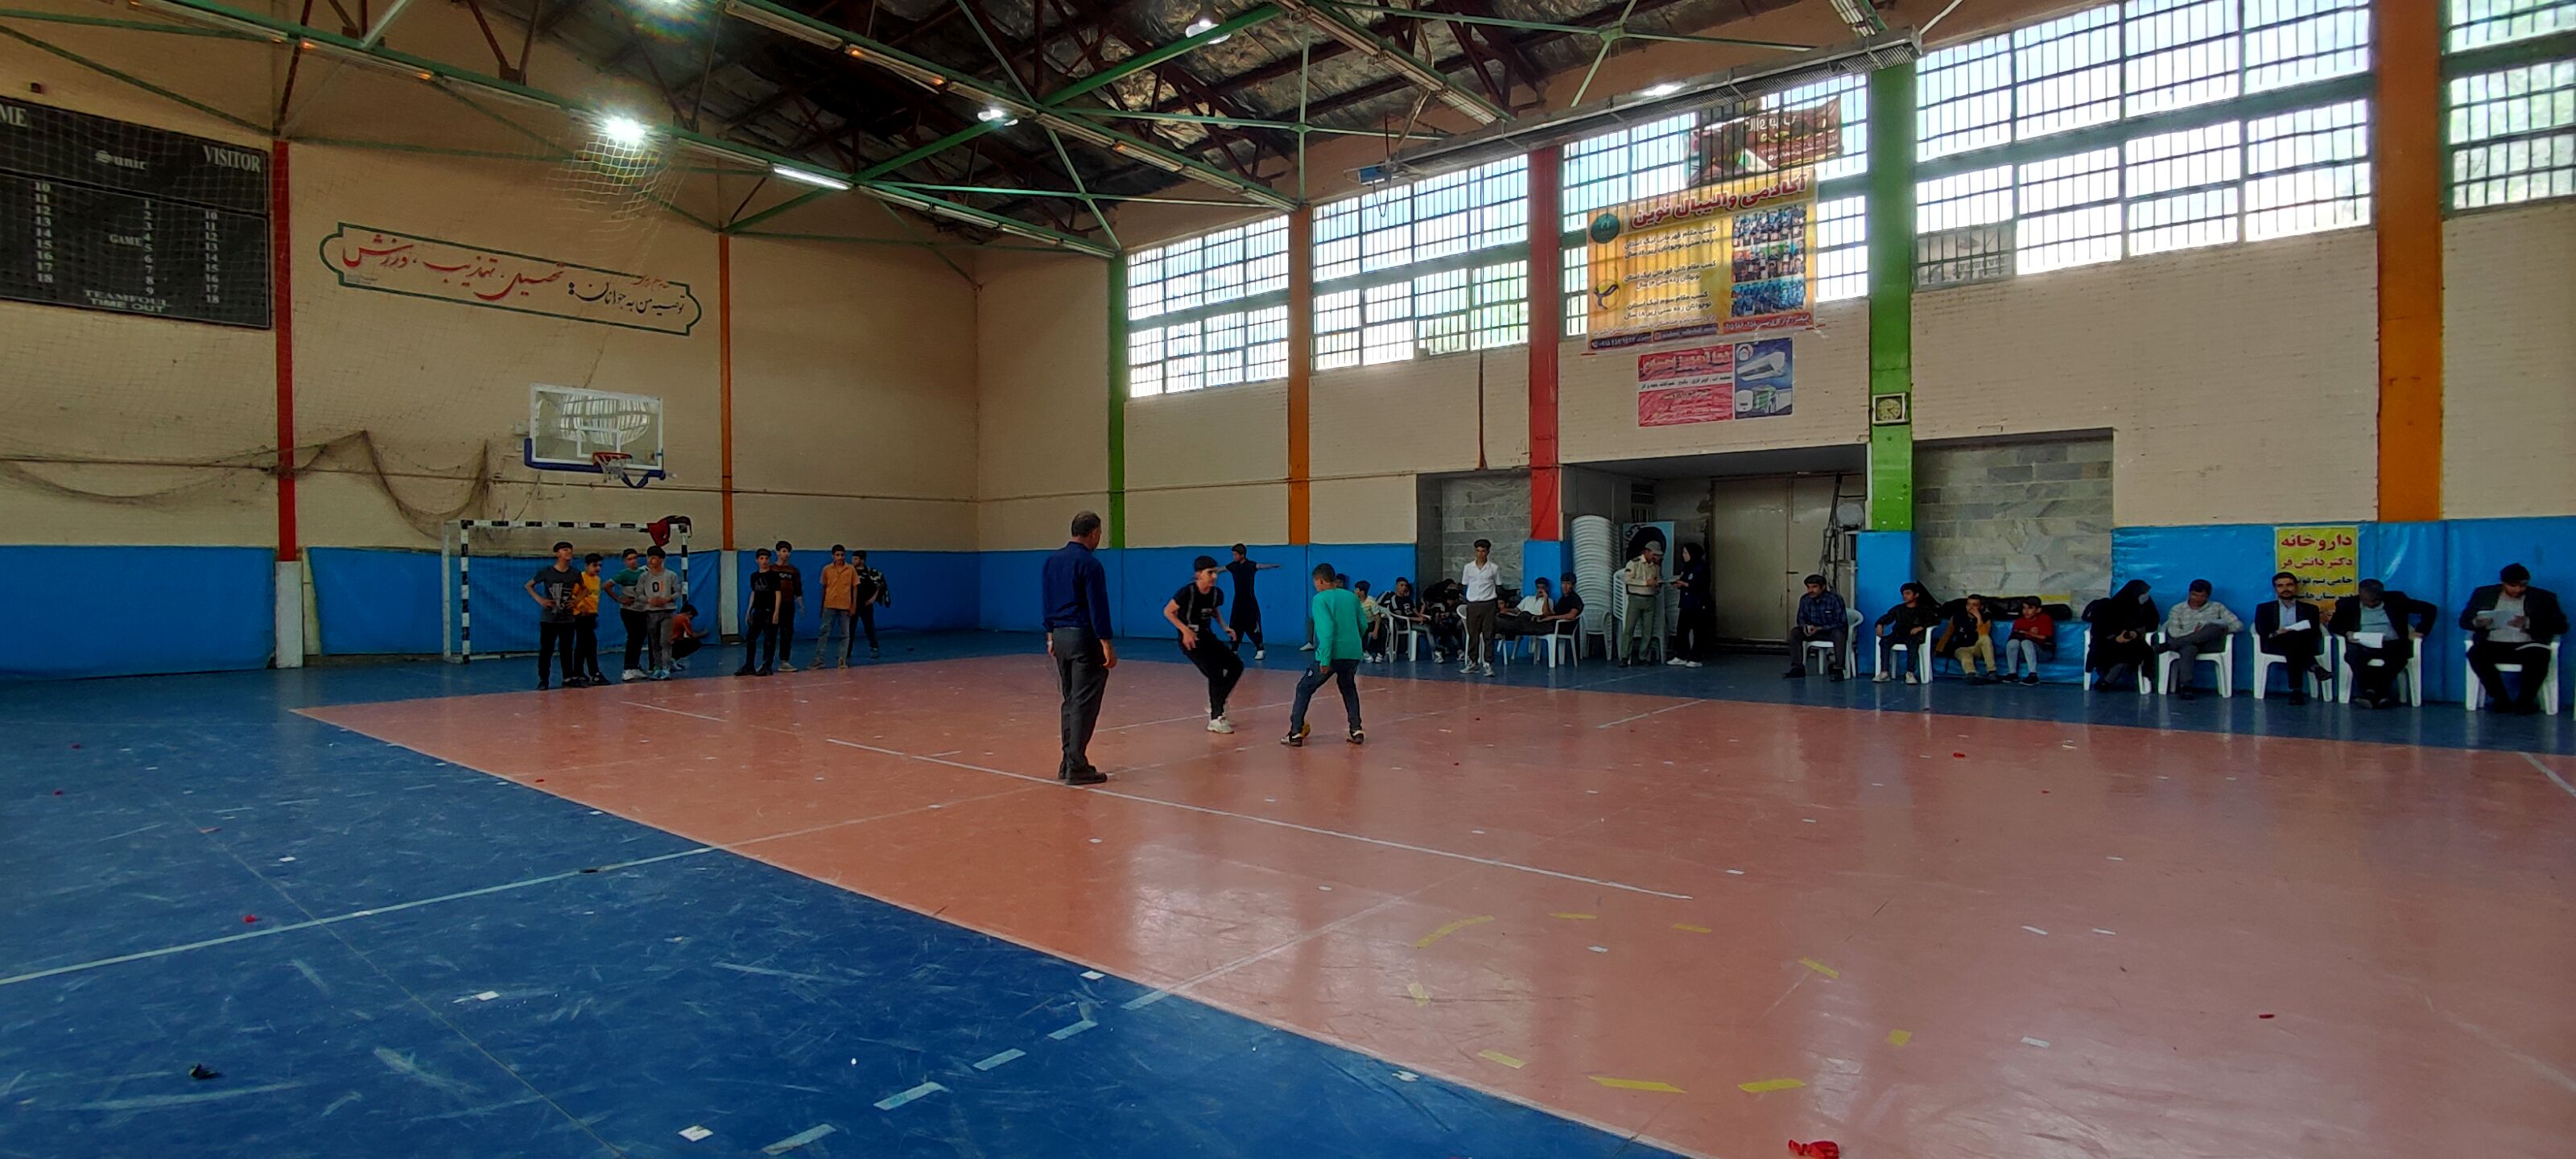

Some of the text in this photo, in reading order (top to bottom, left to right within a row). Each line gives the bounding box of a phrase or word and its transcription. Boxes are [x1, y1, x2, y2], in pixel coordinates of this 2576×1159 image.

[203, 146, 261, 173] VISITOR
[35, 182, 51, 192] 10
[35, 193, 48, 204] 11
[1632, 175, 1807, 227] آکادمی والیبال نوین
[35, 204, 52, 215] 12
[144, 200, 151, 209] 1
[144, 211, 152, 220] 2
[205, 211, 217, 221] 10
[35, 217, 52, 226] 13
[144, 221, 152, 231] 3
[205, 221, 217, 231] 11
[35, 227, 52, 237] 14
[143, 233, 151, 241] 4
[205, 232, 218, 241] 12
[36, 238, 52, 249] 15
[109, 234, 142, 247] GAME
[144, 243, 153, 252] 5
[205, 242, 219, 251] 13
[36, 250, 53, 260] 16
[144, 254, 153, 264] 6
[205, 253, 219, 262] 14
[36, 262, 53, 271] 17
[145, 265, 153, 274] 7
[205, 263, 219, 273] 15
[37, 272, 53, 283] 18
[146, 275, 155, 285] 8
[205, 274, 219, 283] 16
[146, 287, 154, 296] 9
[206, 284, 219, 293] 17
[206, 294, 220, 303] 18
[90, 298, 165, 313] TIME OUT
[625, 301, 635, 312] به
[636, 299, 653, 314] من
[651, 295, 685, 316] توصیه
[2326, 557, 2353, 568] دکتر
